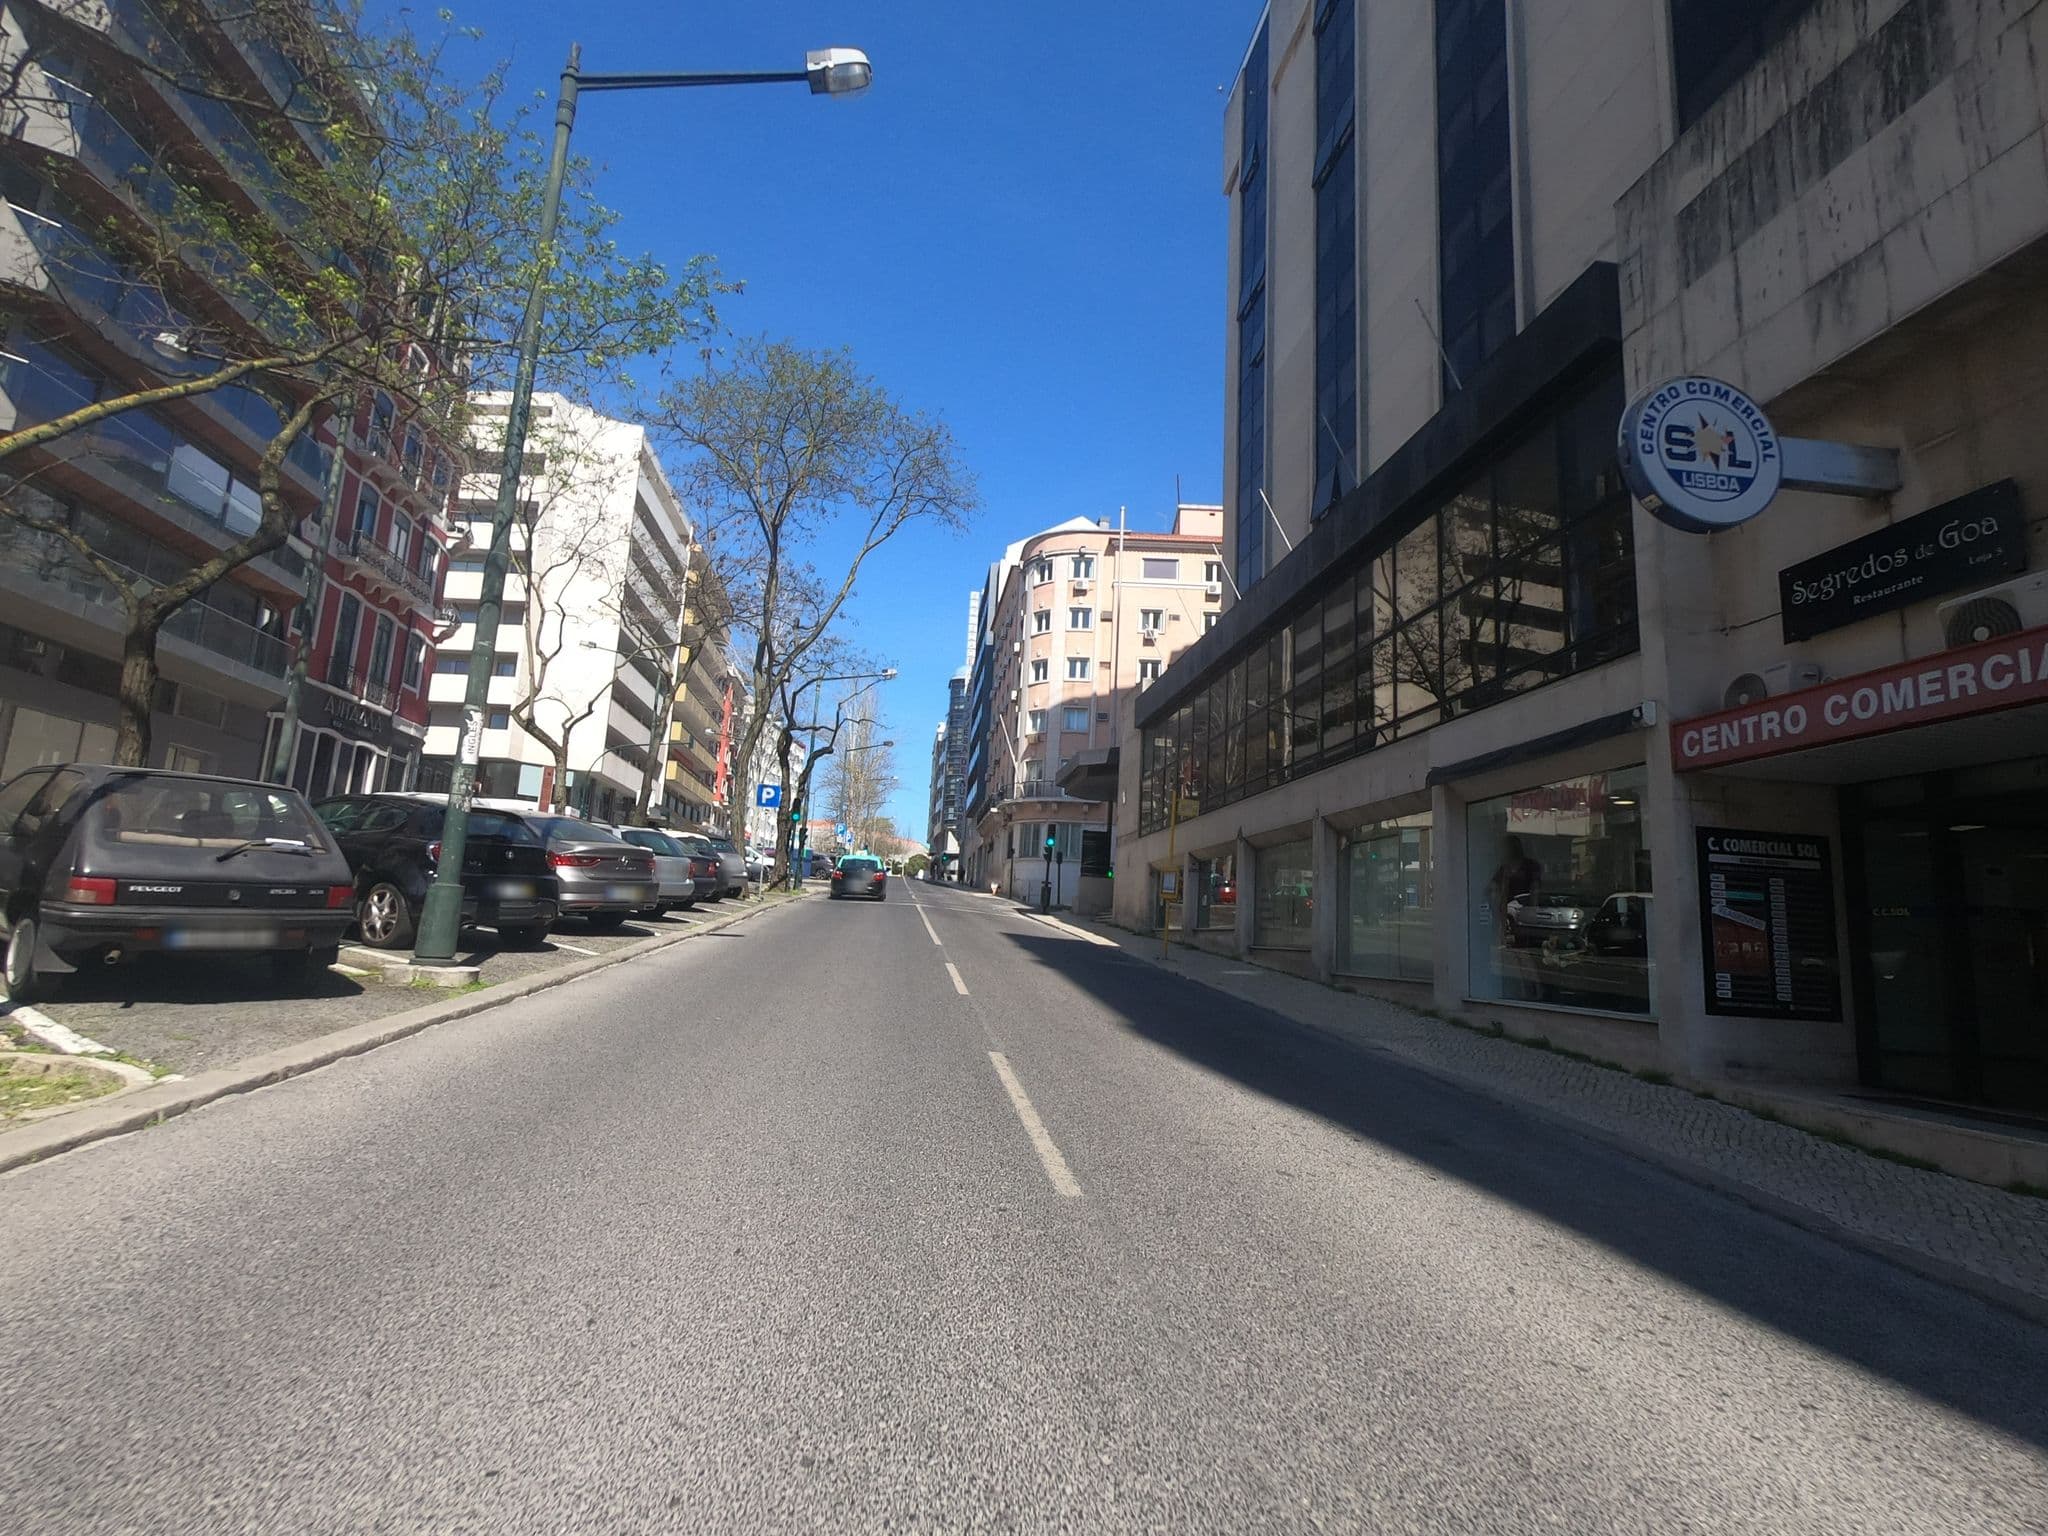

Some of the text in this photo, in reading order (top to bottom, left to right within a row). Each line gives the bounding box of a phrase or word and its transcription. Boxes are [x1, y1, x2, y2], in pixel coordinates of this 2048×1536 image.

[1640, 381, 1776, 463] CENTRO COMERCIAL
[1681, 471, 1742, 493] LISBOA
[1791, 517, 2000, 606] Segredos de Goa
[1853, 574, 1925, 606] Restaurante
[1681, 705, 1808, 759] CENTRO
[761, 787, 776, 805] P
[1722, 838, 1794, 856] COMERCIAL
[1796, 843, 1821, 858] SOL
[128, 884, 184, 894] PEUGEOT
